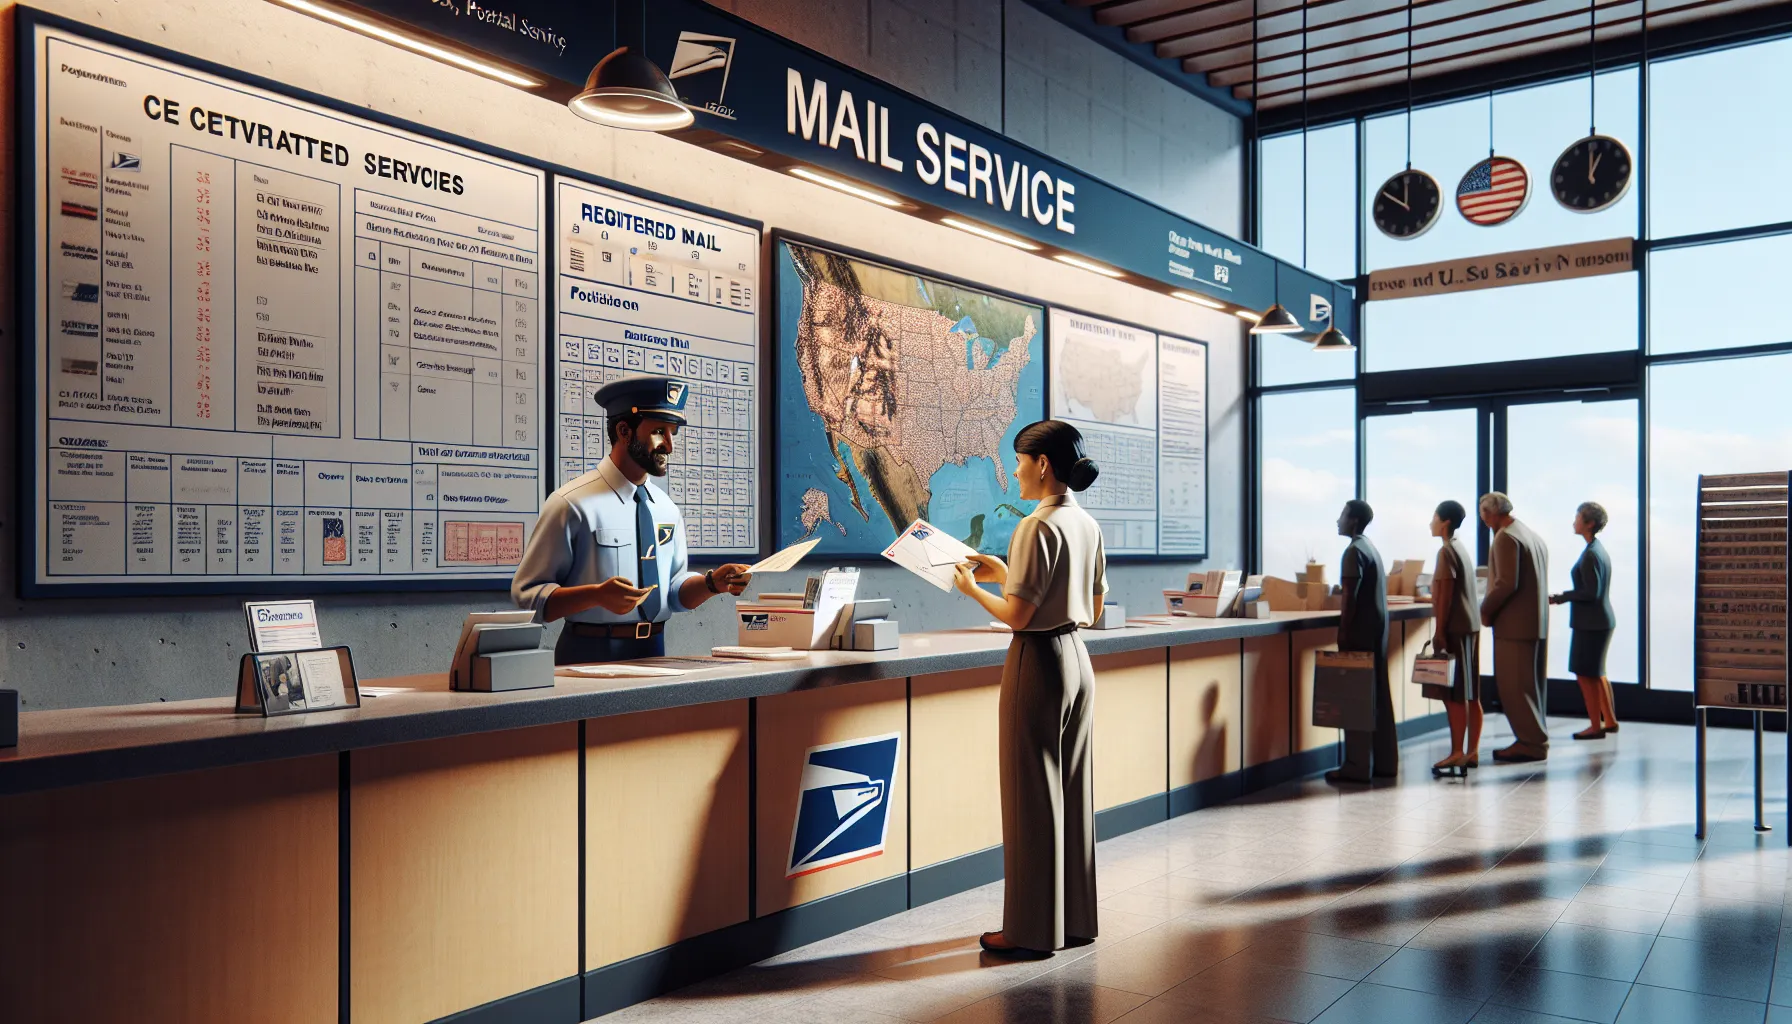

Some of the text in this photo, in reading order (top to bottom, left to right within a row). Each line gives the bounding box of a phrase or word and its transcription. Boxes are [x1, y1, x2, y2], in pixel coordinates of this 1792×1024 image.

[143, 94, 465, 196] CE CETVRATTED SERVCIES
[786, 67, 1076, 235] MAIL SERVICE
